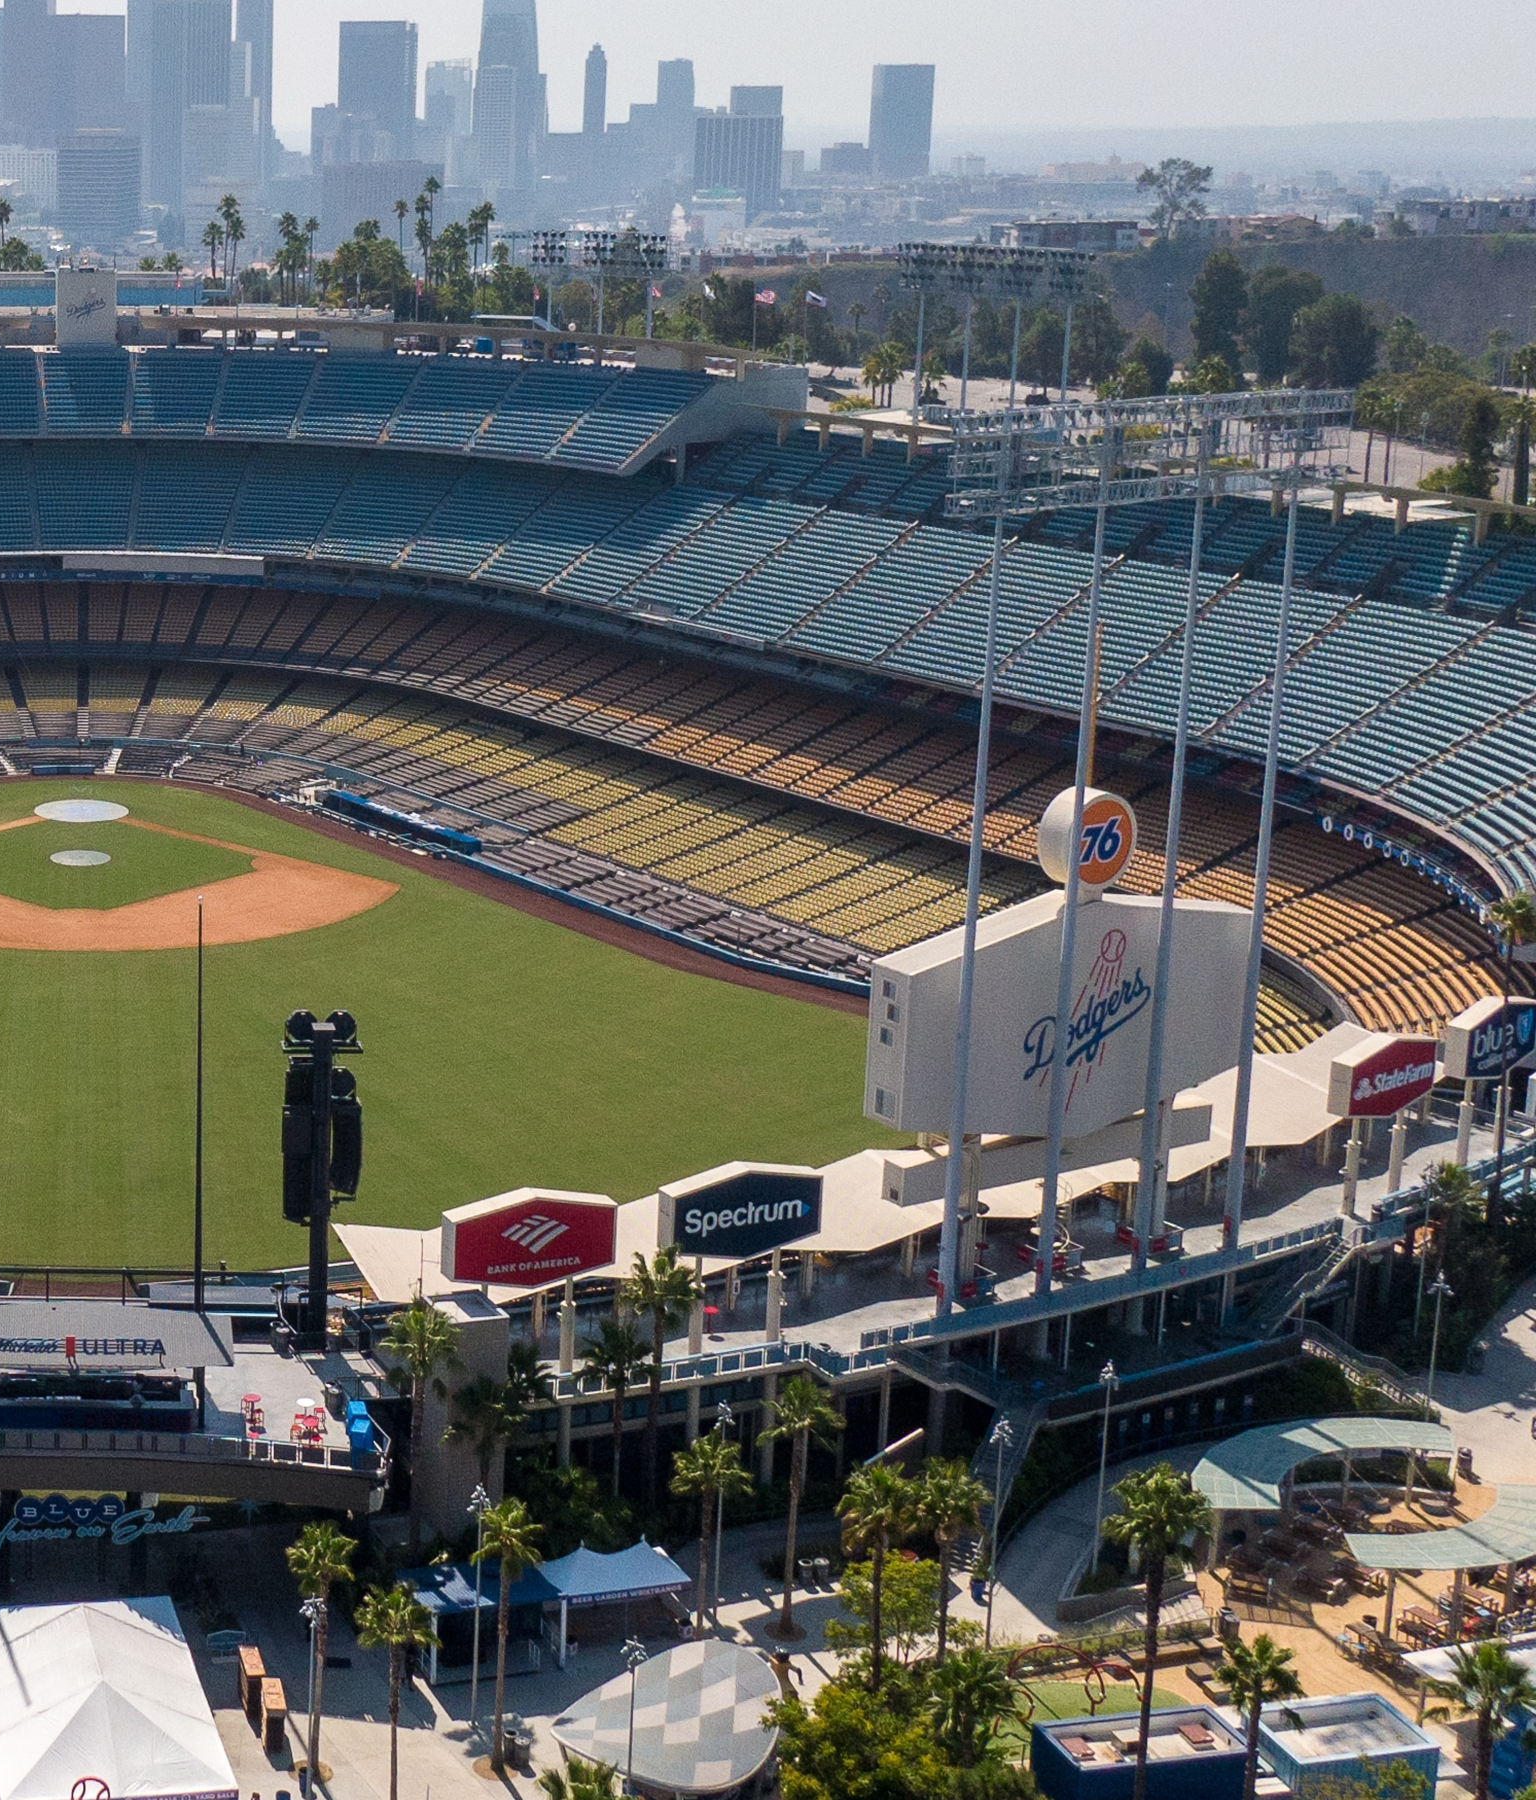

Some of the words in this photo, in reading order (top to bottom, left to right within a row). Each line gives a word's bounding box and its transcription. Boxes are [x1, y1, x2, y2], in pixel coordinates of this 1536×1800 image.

[66, 298, 106, 318] Dodgers
[1079, 815, 1122, 865] 76
[1473, 1023, 1514, 1058] blue
[685, 1199, 803, 1237] Spectrum
[487, 1264, 516, 1274] BANK
[518, 1262, 532, 1271] OF
[534, 1256, 581, 1269] AMERICA
[82, 1338, 166, 1355] ULTRA
[23, 1503, 117, 1518] BLUE
[76, 1526, 106, 1538] on
[111, 1505, 210, 1545] Earth
[572, 1596, 593, 1604] BEER
[594, 1592, 628, 1601] GARDEN
